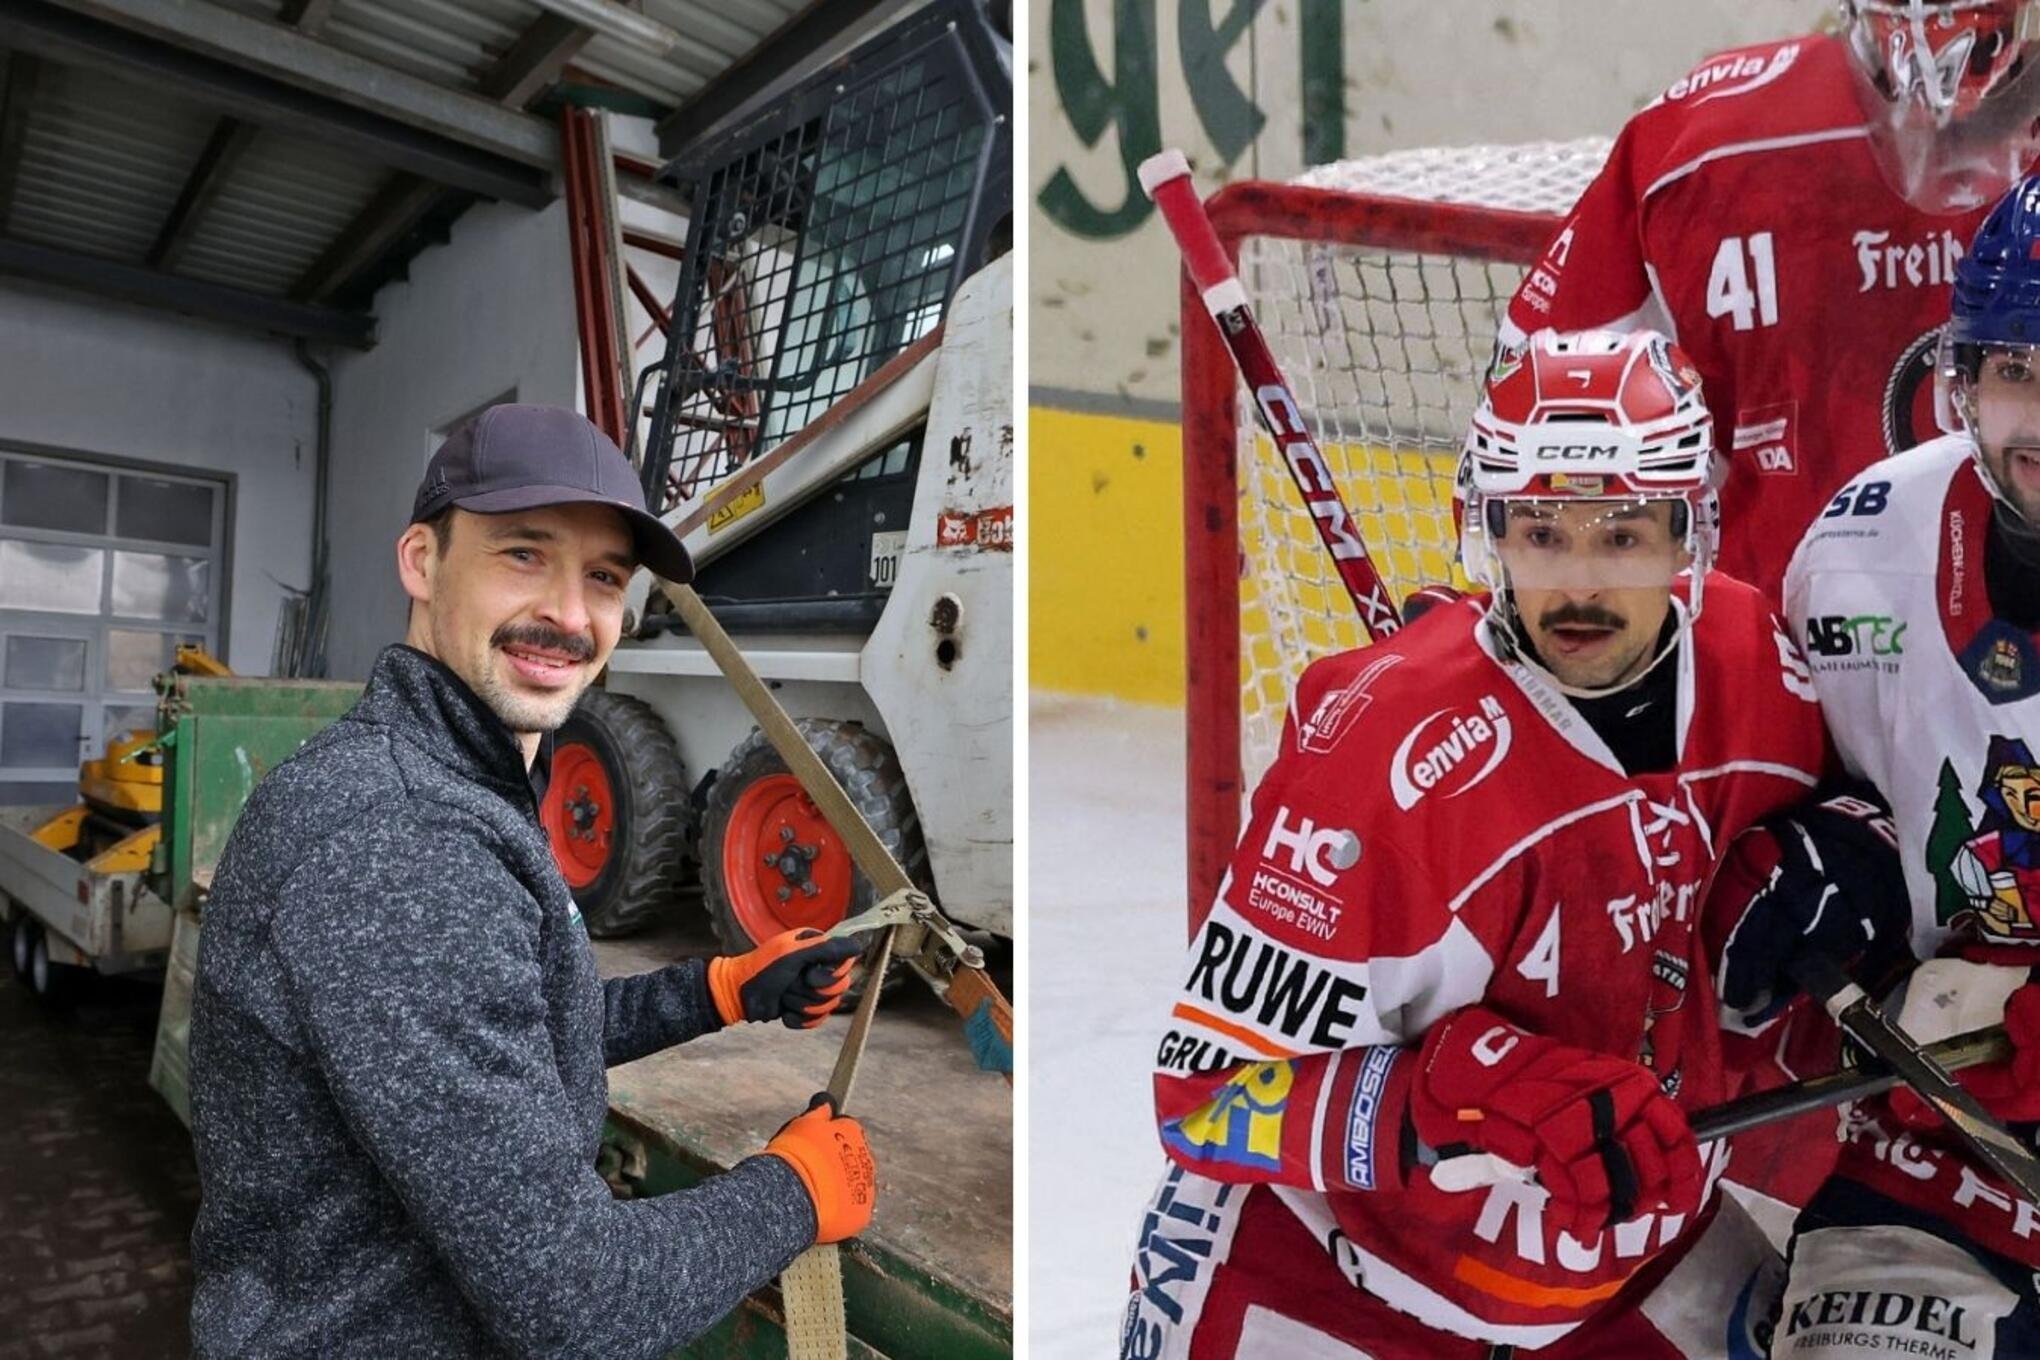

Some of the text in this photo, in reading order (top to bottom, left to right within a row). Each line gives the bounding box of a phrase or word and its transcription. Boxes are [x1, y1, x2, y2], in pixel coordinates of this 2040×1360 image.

[1706, 231, 1779, 331] 41
[1257, 385, 1365, 561] CCM
[1536, 445, 1619, 460] CCM
[1249, 888, 1337, 940] Europe EWIV
[1253, 871, 1342, 923] HCONSULT
[1517, 903, 1561, 997] 4
[1185, 921, 1367, 1048] RUWE
[1158, 1031, 1250, 1073] GRU
[1787, 1291, 1976, 1350] KEIDEL
